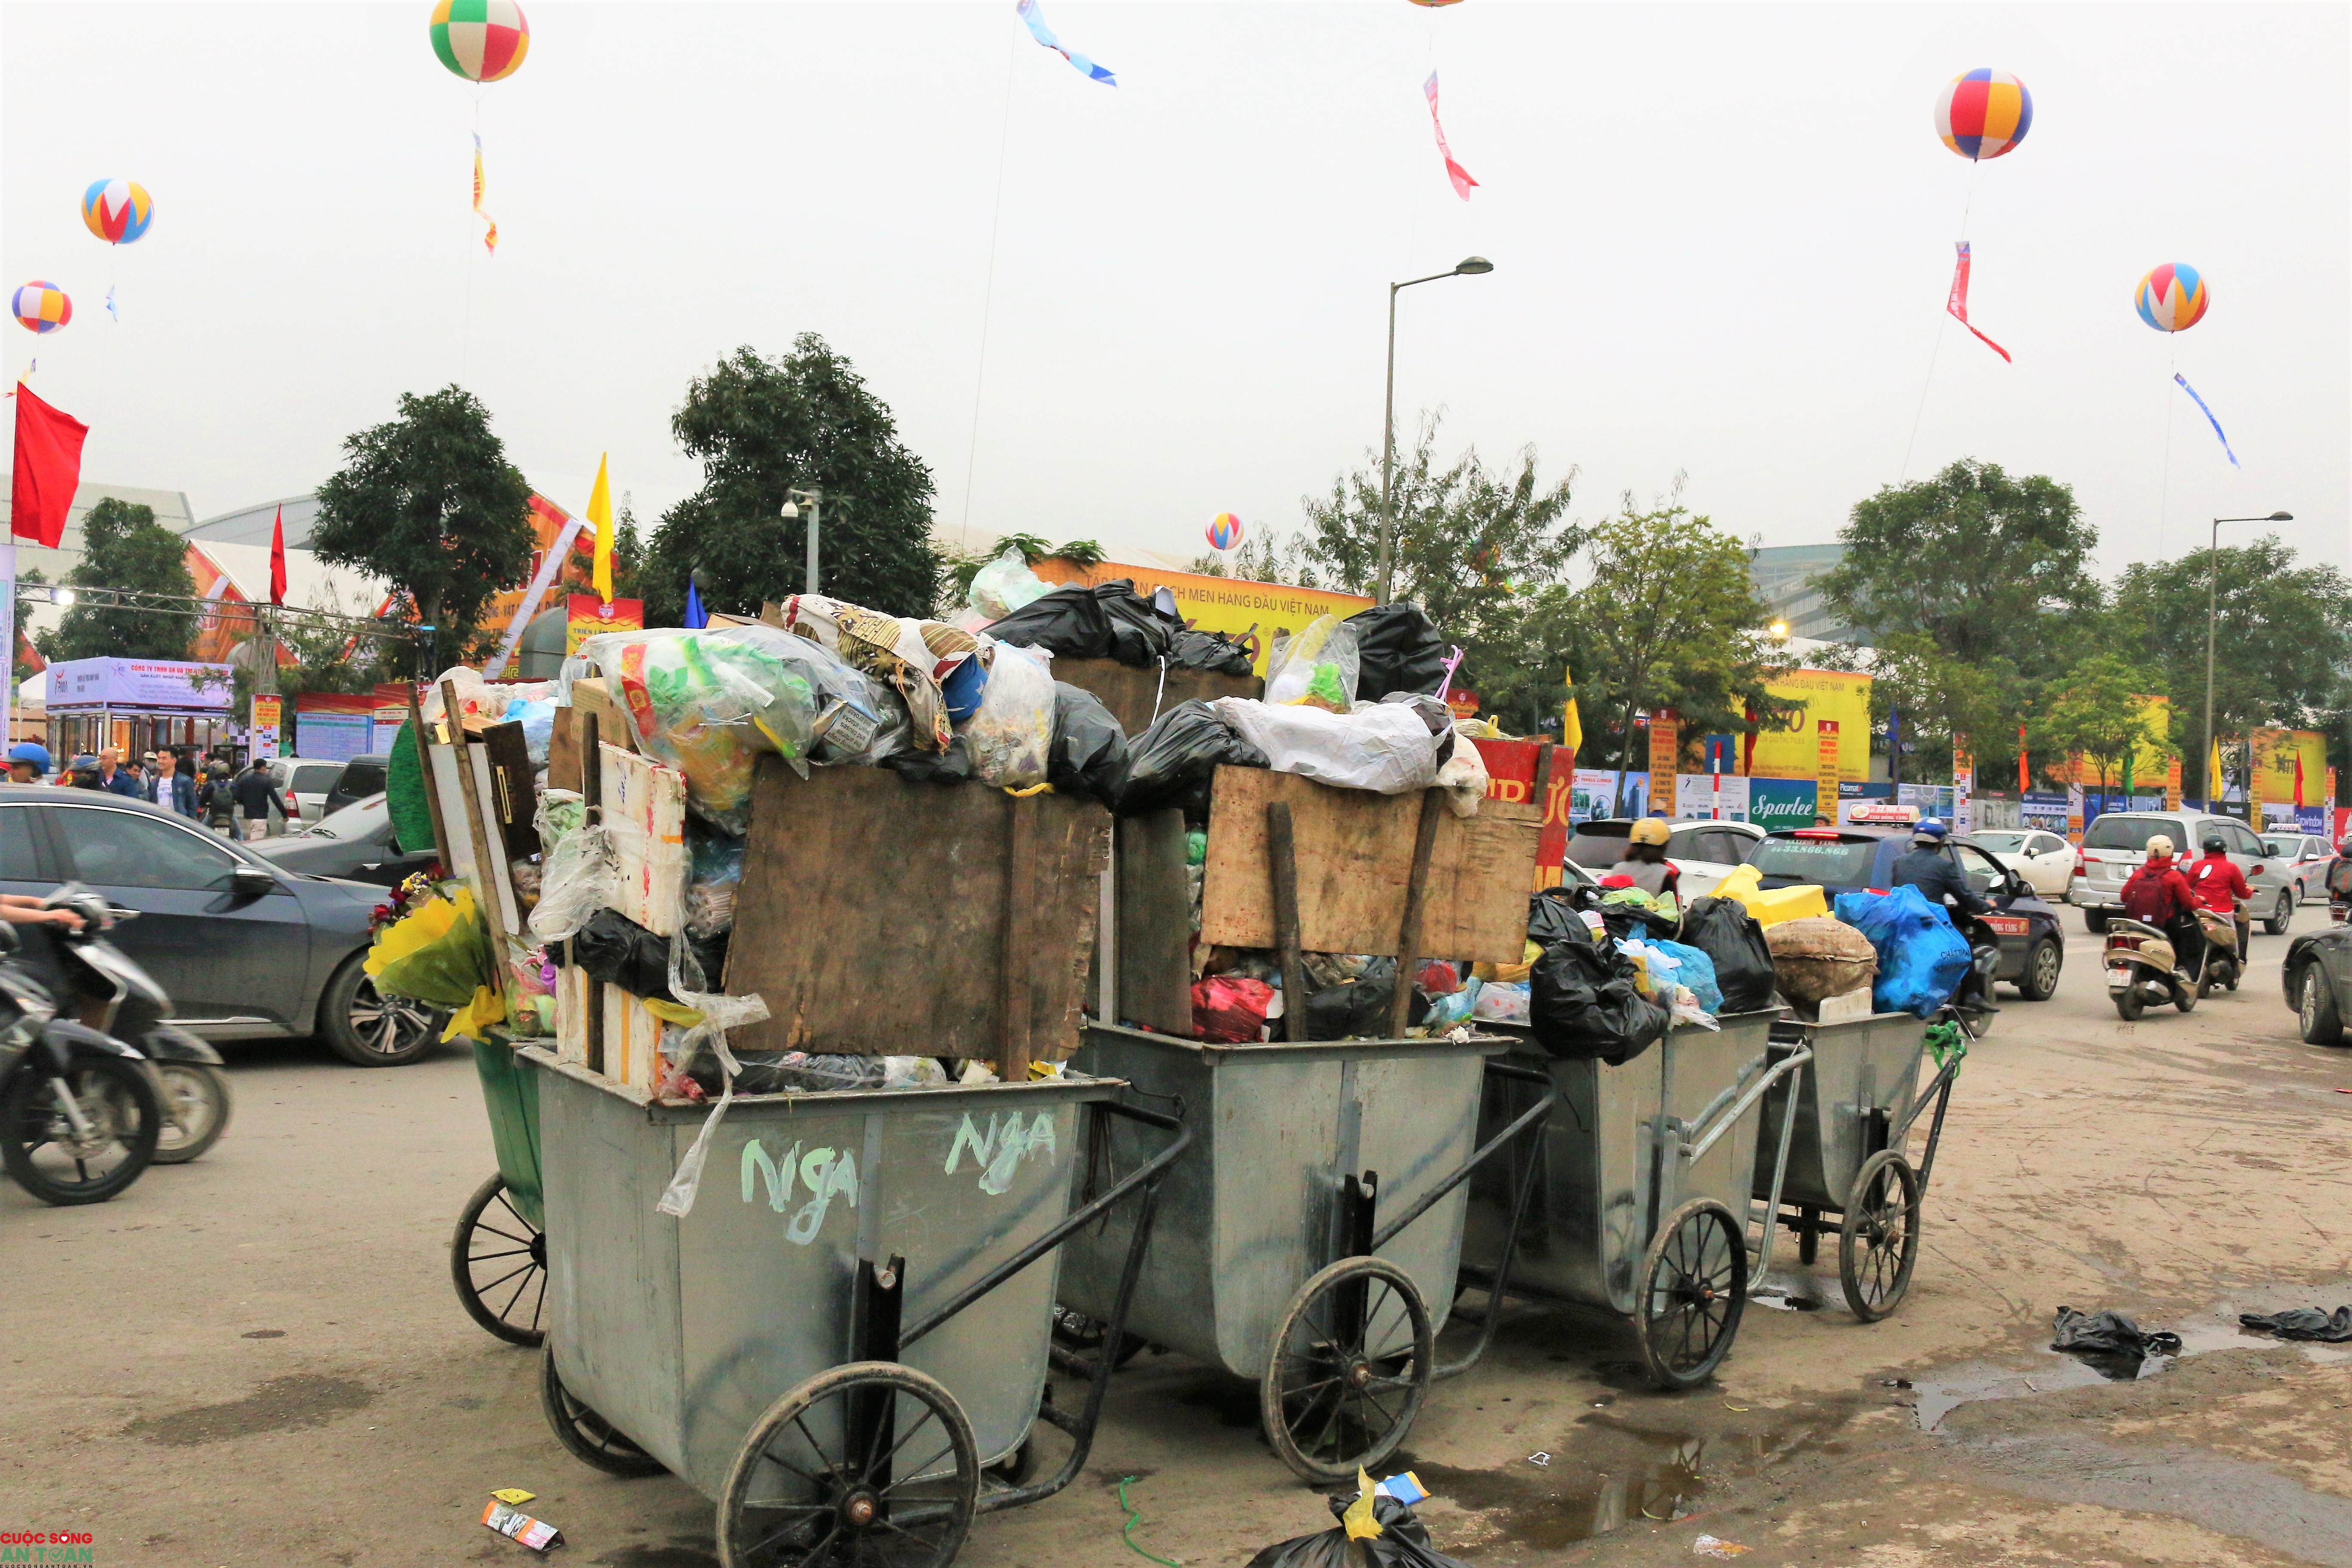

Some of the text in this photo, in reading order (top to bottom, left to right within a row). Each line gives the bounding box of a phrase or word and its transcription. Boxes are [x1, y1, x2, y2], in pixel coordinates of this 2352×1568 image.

[1189, 588, 1215, 603] MEN
[1218, 591, 1250, 607] HÀNG
[1254, 592, 1277, 610] ĐẦU
[1280, 598, 1302, 616] VIỆT
[1305, 603, 1329, 616] NAM
